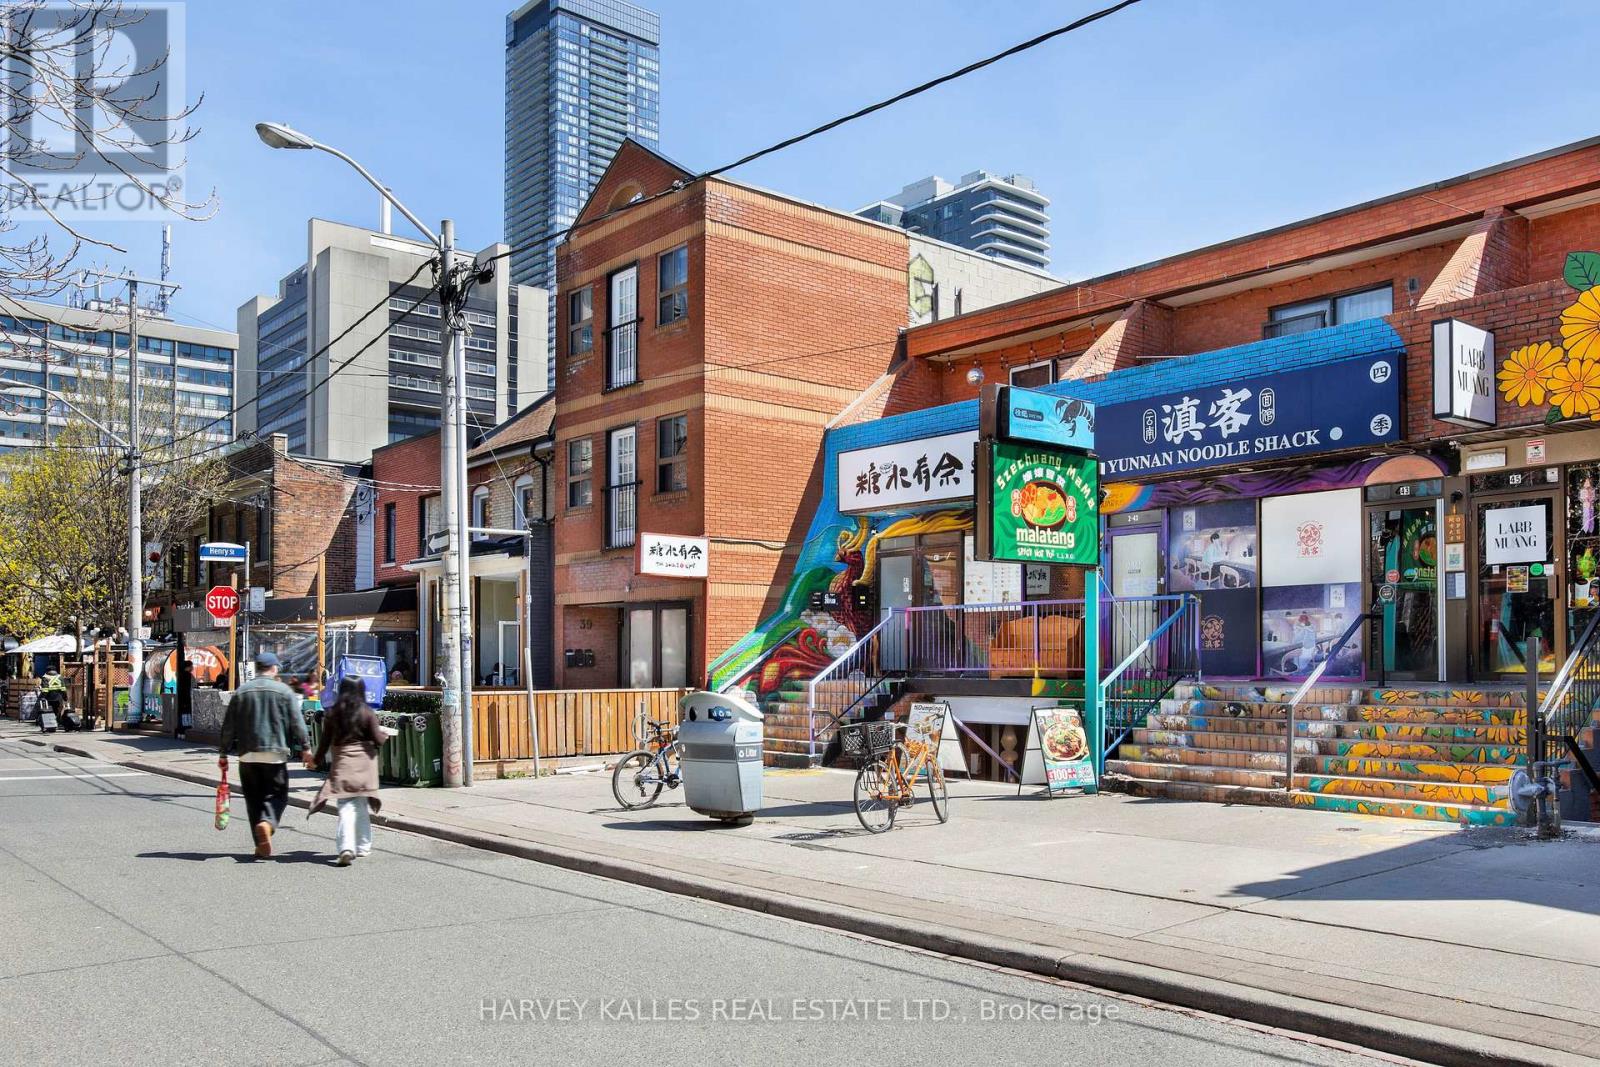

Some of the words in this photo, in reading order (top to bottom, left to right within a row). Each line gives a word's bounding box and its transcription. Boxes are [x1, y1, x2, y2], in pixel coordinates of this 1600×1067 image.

[1461, 344, 1486, 371] LARB
[1457, 369, 1489, 397] MUANG
[1161, 387, 1252, 445] 滇客
[1107, 451, 1174, 474] YUNNAN
[1176, 439, 1251, 464] NOODLE
[1254, 429, 1321, 453] SHACK
[1510, 475, 1521, 484] 45
[1400, 486, 1410, 496] 43
[1499, 521, 1532, 535] LARB
[1016, 526, 1075, 549] malatang
[1494, 535, 1537, 549] MUANG
[209, 547, 229, 557] Henry
[208, 595, 237, 609] STOP
[579, 619, 593, 630] 39
